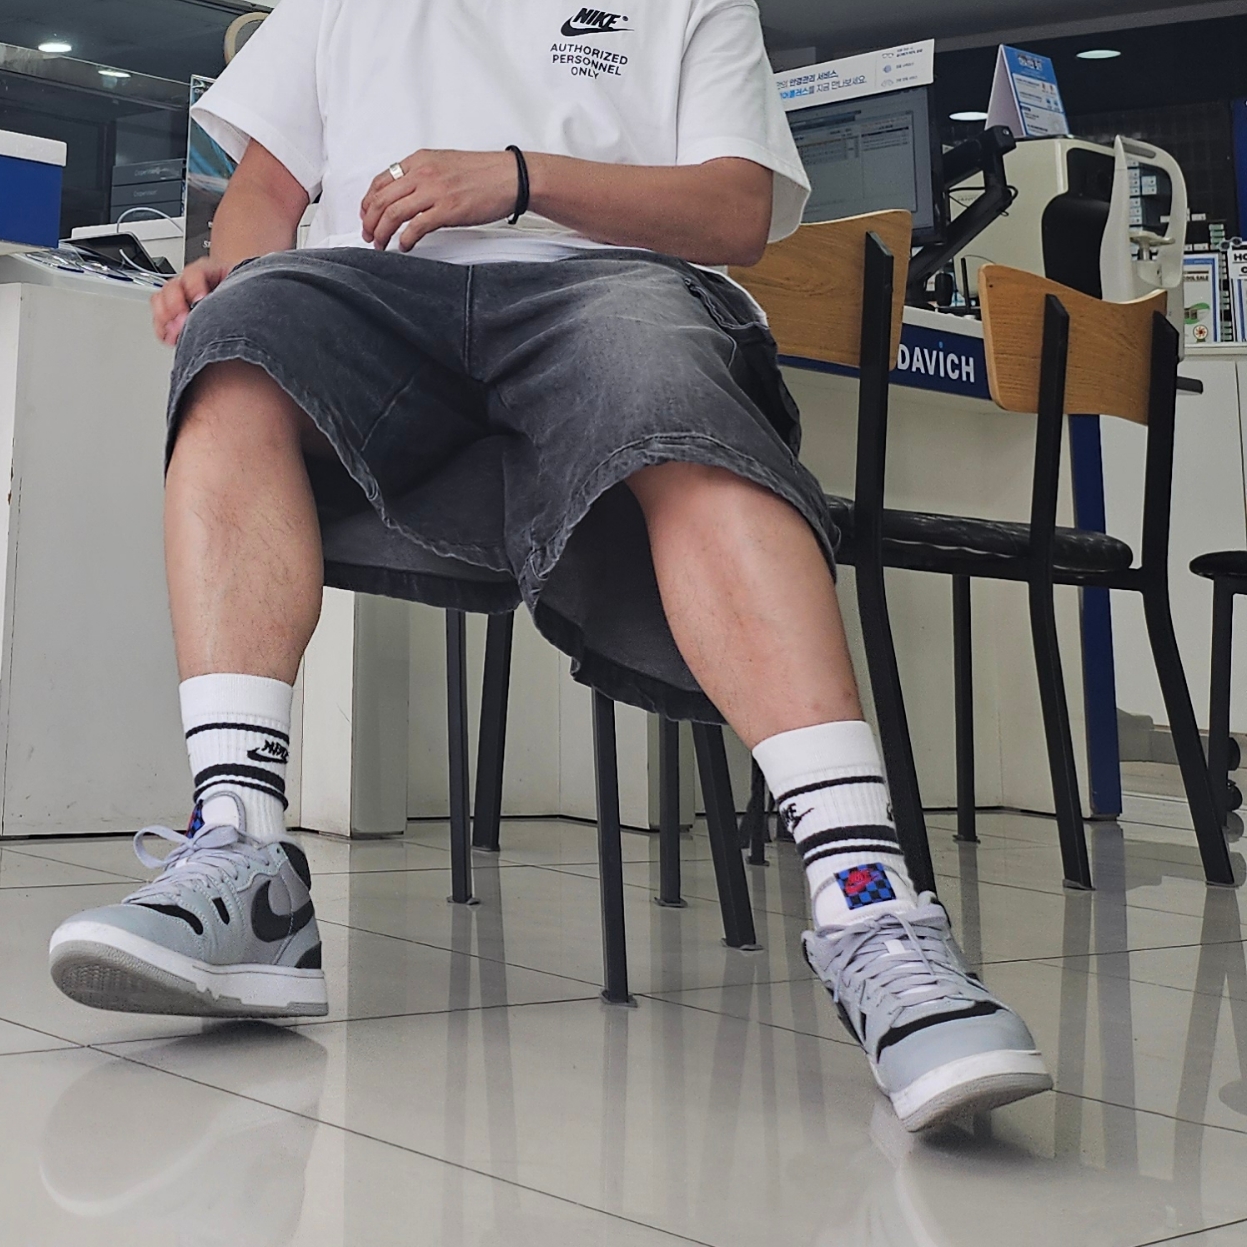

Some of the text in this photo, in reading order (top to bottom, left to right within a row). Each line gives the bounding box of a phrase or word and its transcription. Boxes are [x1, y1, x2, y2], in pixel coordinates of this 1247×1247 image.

[572, 8, 621, 29] NIKE
[550, 43, 628, 65] AUTHORIZED
[552, 54, 621, 76] PERSONNEL
[571, 67, 599, 80] ONLY
[897, 342, 974, 383] DAVICH
